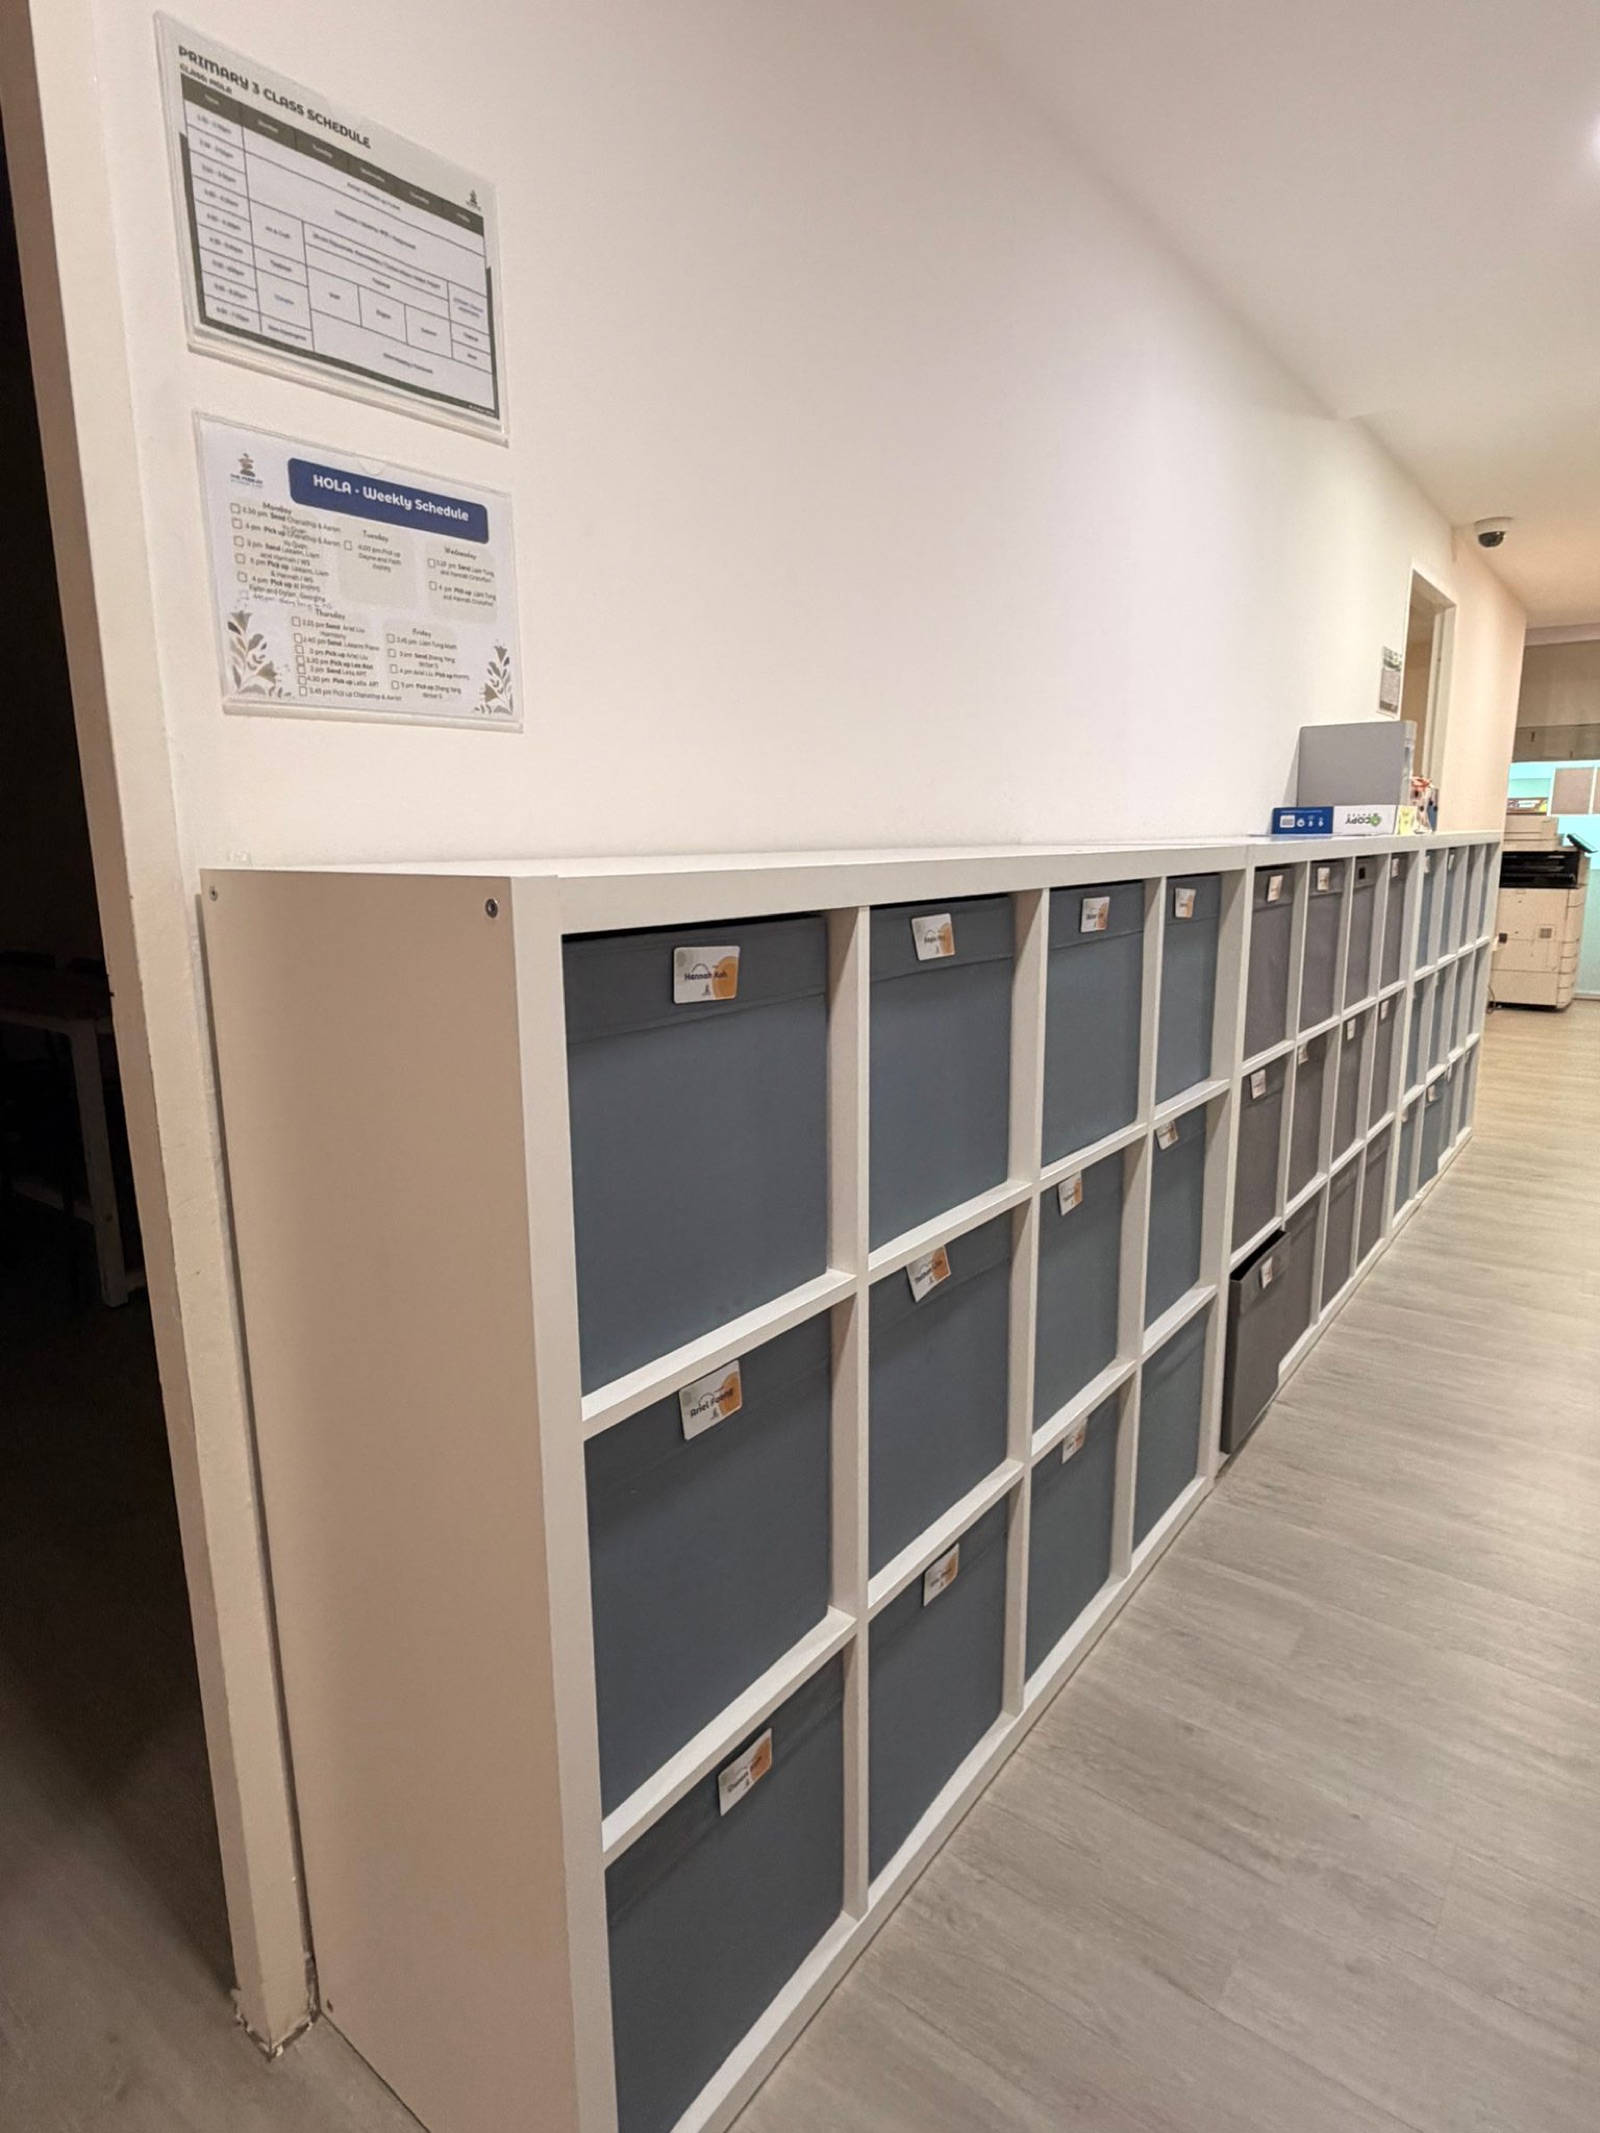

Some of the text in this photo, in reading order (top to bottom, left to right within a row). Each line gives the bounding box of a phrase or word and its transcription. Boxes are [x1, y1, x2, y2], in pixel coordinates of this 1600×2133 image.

[178, 45, 249, 90] PRIMARY
[252, 82, 260, 95] 3
[263, 88, 304, 116] CLASS
[307, 109, 371, 149] SCHEDULE
[313, 474, 351, 494] HOLA
[363, 487, 412, 510] Weekly
[414, 499, 469, 521] Schedule
[271, 513, 285, 521] Send
[264, 526, 276, 534] Pick
[363, 530, 388, 543] Tuesday
[268, 561, 279, 569] Pick
[271, 578, 282, 586] Pick
[316, 608, 345, 620] Thursday
[326, 622, 340, 630] Send
[412, 628, 431, 638] Friday
[1345, 817, 1371, 825] COPY
